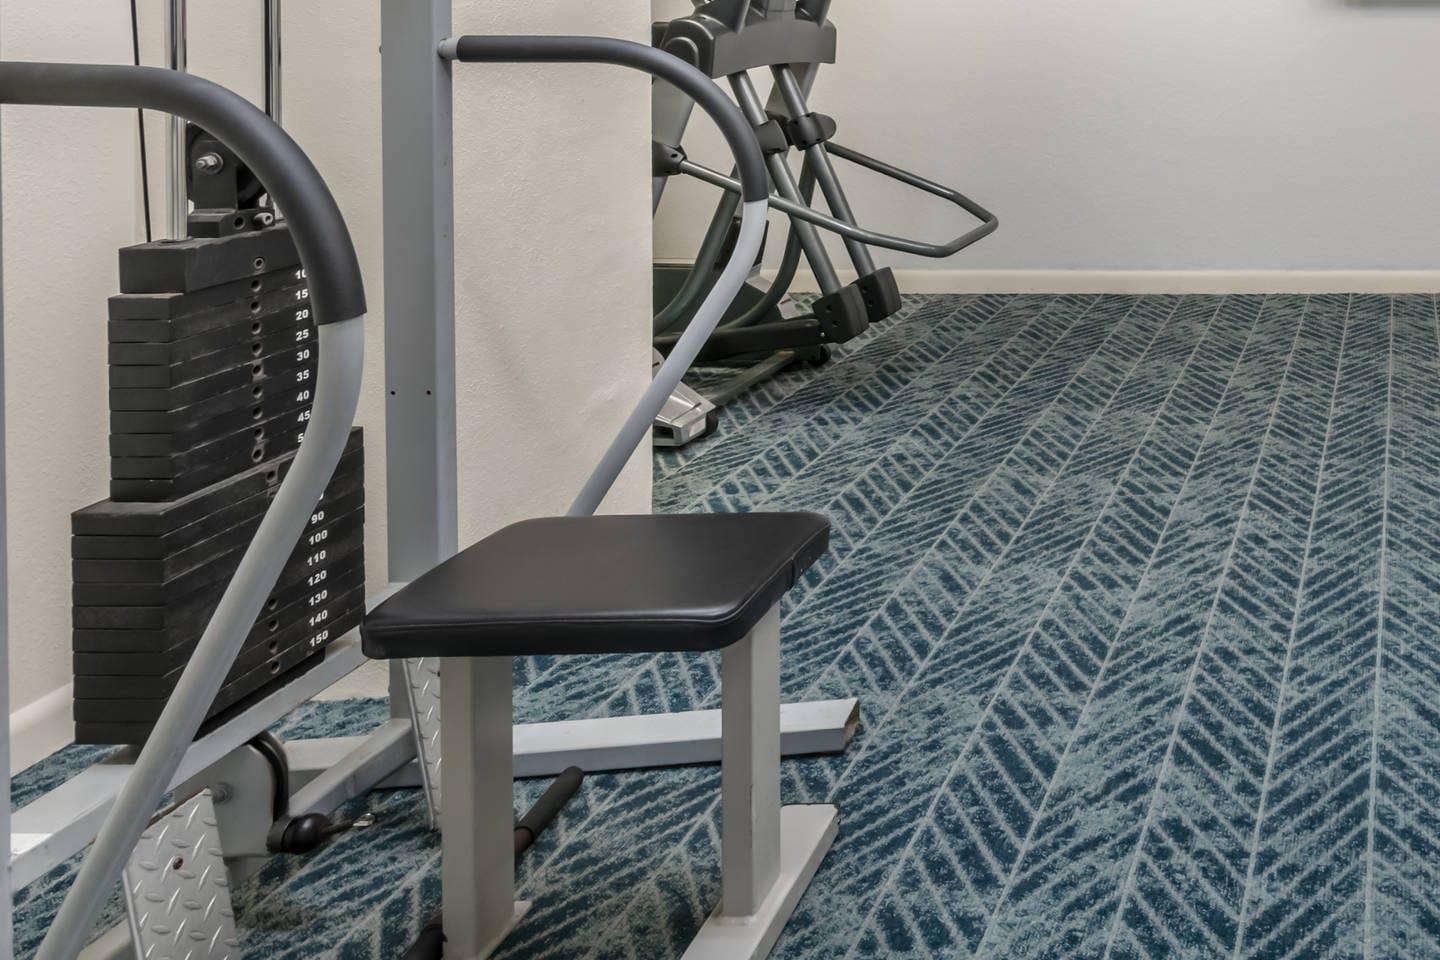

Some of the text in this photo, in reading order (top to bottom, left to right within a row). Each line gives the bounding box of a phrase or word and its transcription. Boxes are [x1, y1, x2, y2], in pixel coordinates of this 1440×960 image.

[295, 288, 308, 300] 15
[295, 309, 309, 321] 20
[295, 329, 309, 341] 25
[296, 349, 310, 362] 30
[296, 369, 310, 382] 35
[296, 390, 310, 402] 40
[297, 410, 311, 423] 45
[311, 511, 325, 525] 90
[308, 530, 328, 545] 100
[307, 550, 327, 567] 110
[307, 570, 327, 587] 120
[308, 590, 328, 607] 130
[308, 610, 328, 627] 140
[309, 630, 329, 647] 150
